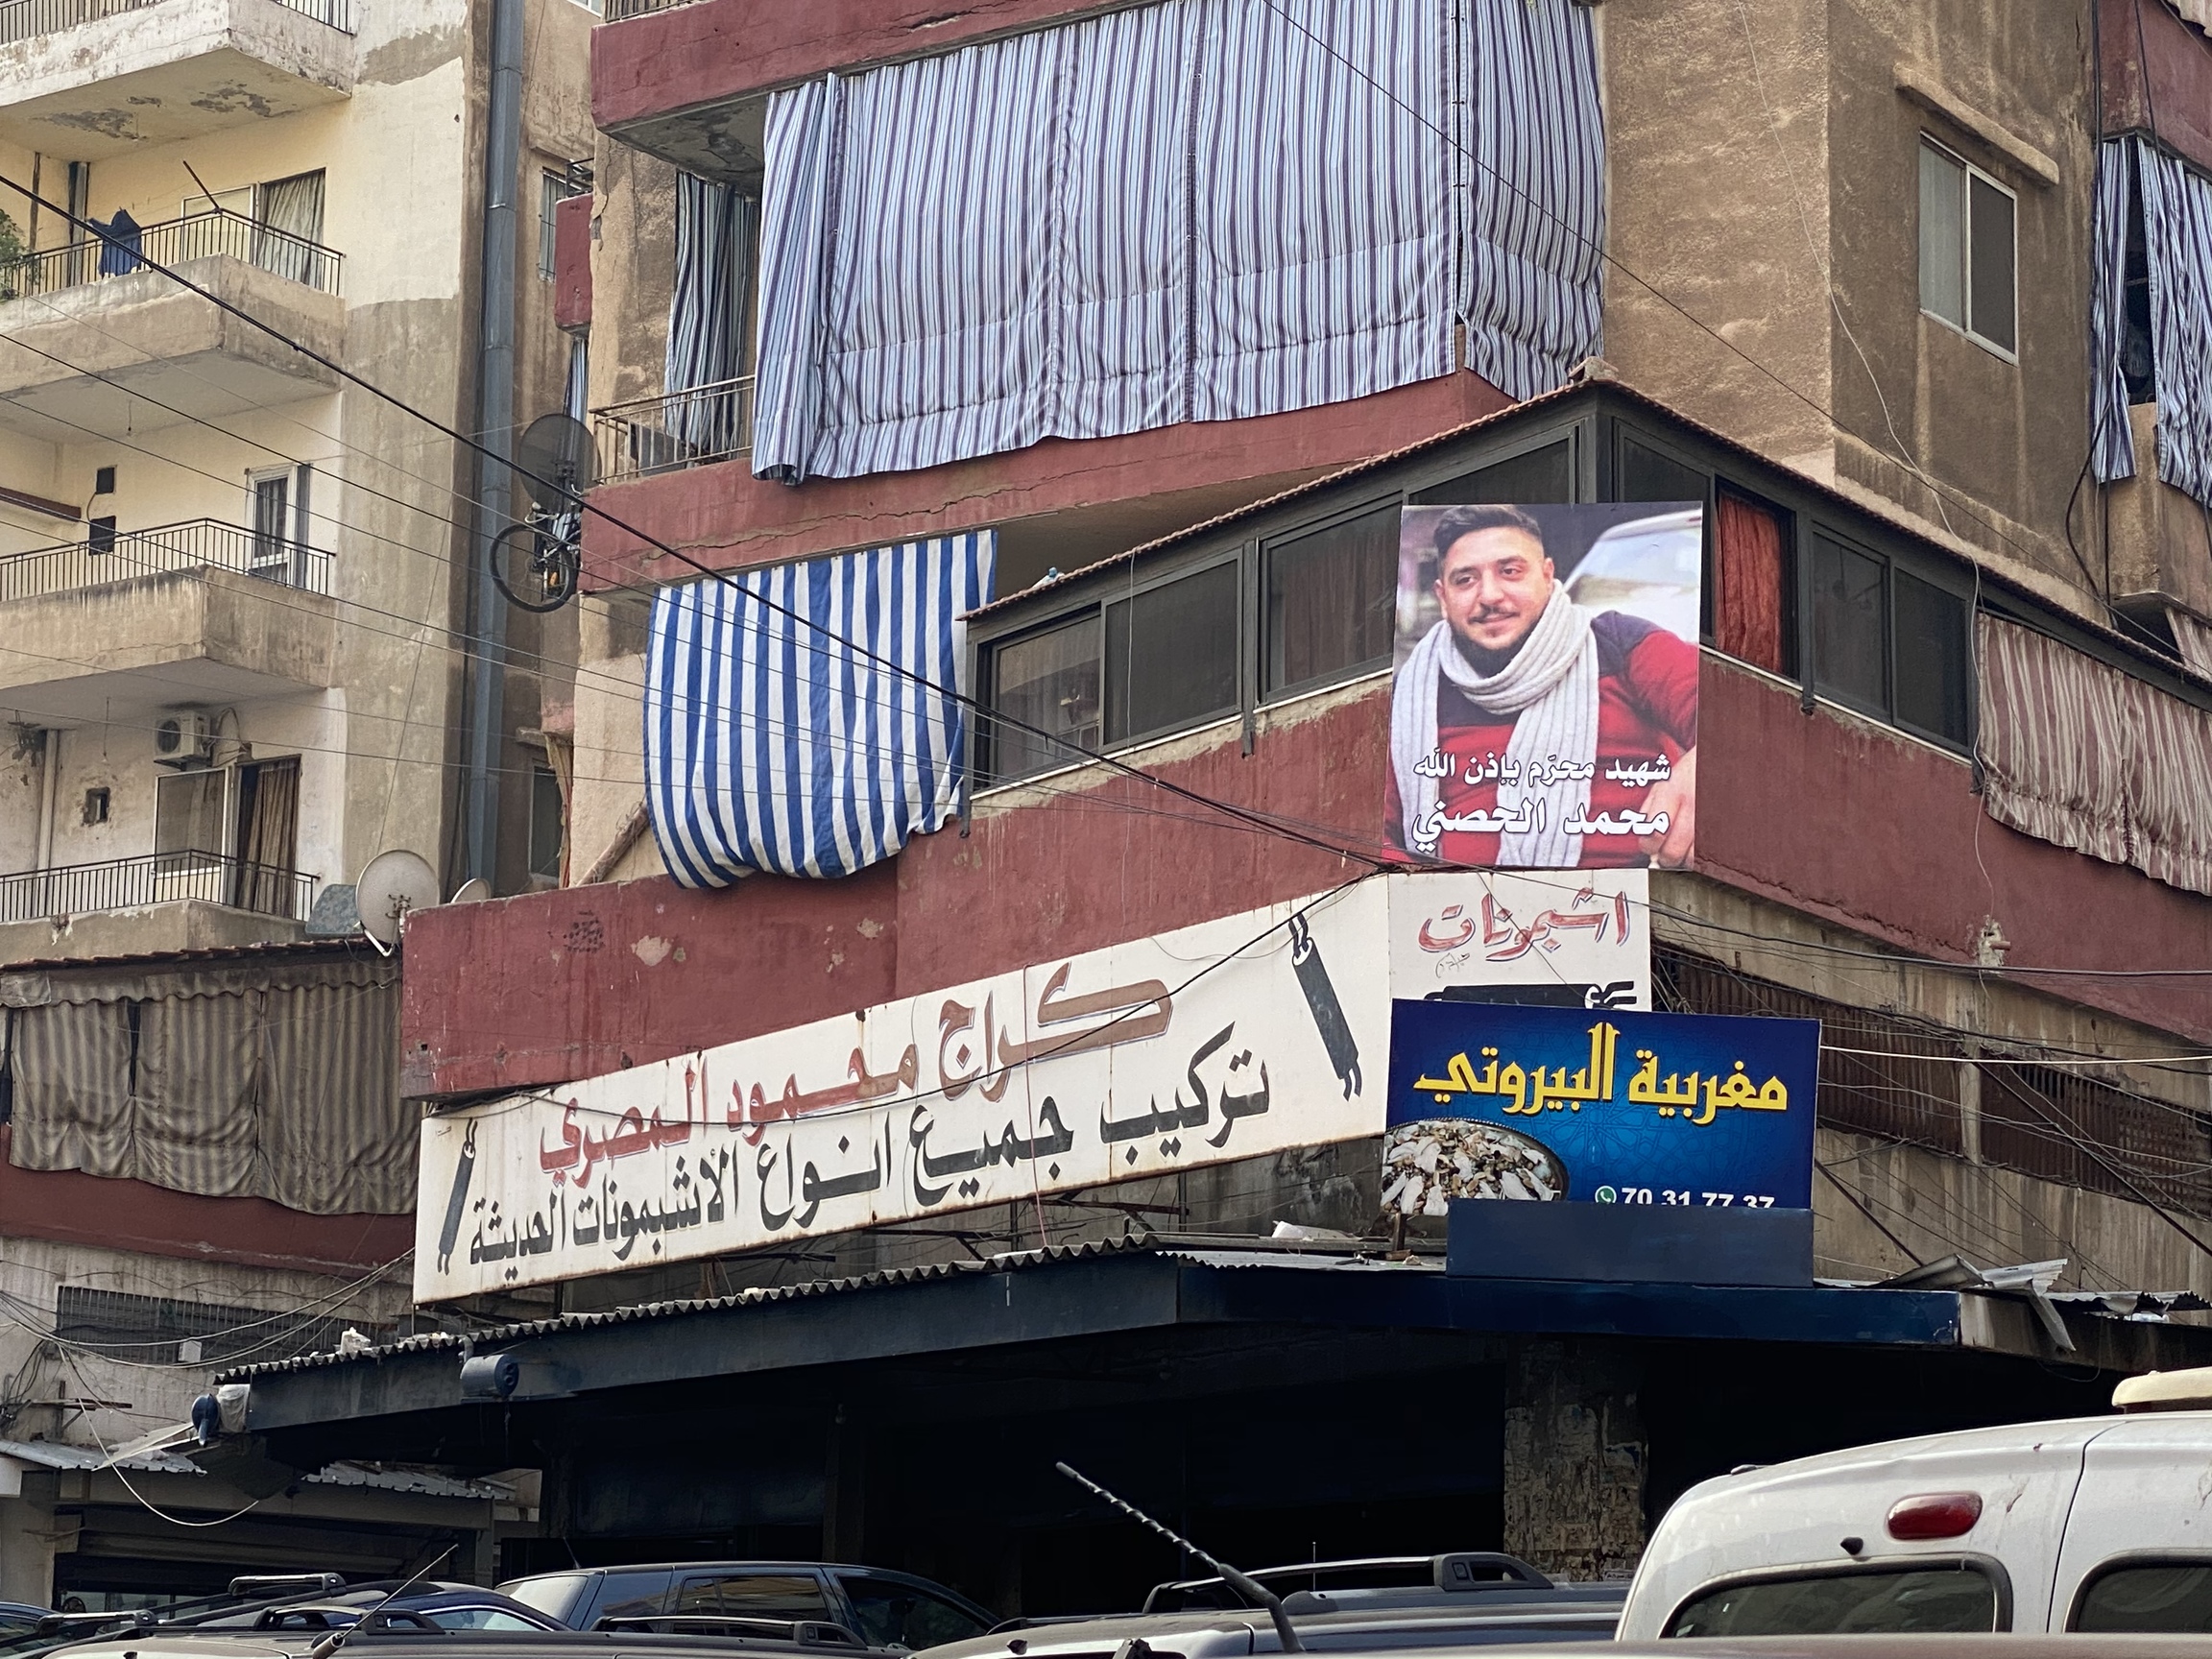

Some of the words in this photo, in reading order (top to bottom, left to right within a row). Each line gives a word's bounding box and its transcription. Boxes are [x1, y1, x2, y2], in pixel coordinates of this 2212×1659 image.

[1463, 751, 1522, 785] بإذن
[1604, 753, 1672, 787] شهيد
[1411, 797, 1547, 854] الحصني
[1562, 802, 1671, 835] محمد
[938, 962, 1173, 1102] كراج
[1413, 1022, 1621, 1116] البيروتي
[540, 1056, 714, 1190] المصري
[727, 1044, 919, 1147] محمود
[1099, 1022, 1270, 1166] تركيب
[1628, 1048, 1789, 1124] مغربية
[757, 1111, 892, 1231] انواع
[909, 1095, 1074, 1207] جميع
[1621, 1187, 1653, 1205] 70
[469, 1189, 566, 1281] الحديثة
